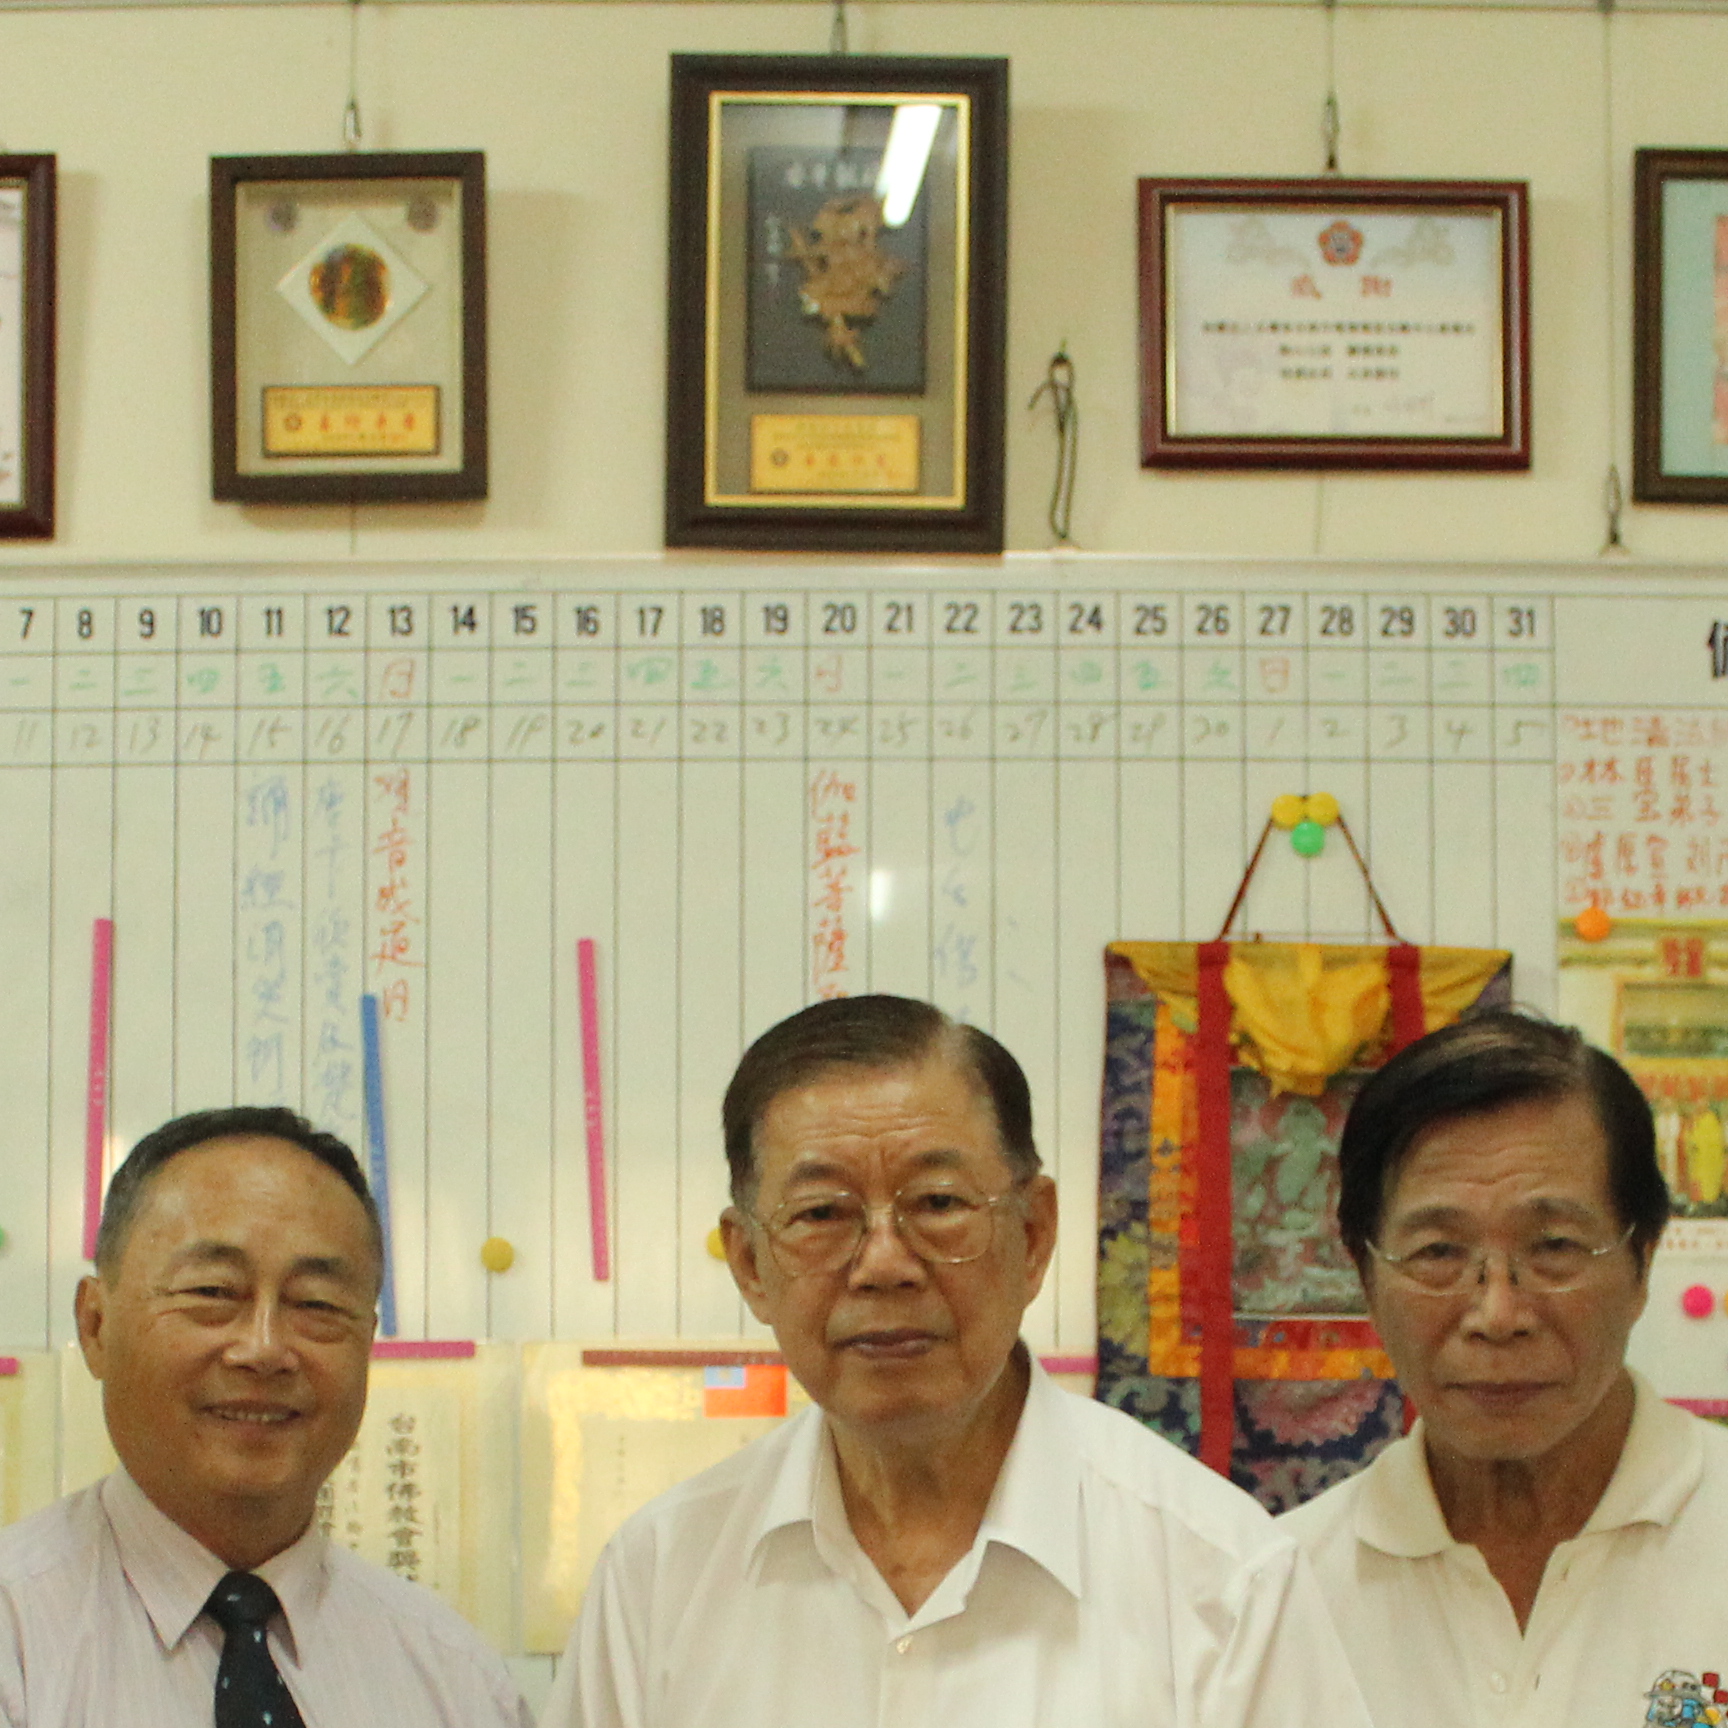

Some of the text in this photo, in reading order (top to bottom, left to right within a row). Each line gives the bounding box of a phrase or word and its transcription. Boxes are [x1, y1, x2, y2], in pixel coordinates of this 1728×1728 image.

[21, 608, 34, 639] 7
[78, 609, 93, 640] 8
[139, 609, 155, 639] 9
[199, 607, 223, 637] 10
[264, 608, 283, 636] 11
[326, 605, 351, 637] 12
[388, 605, 414, 636] 13
[452, 606, 477, 632] 14
[513, 605, 537, 635] 15
[575, 605, 599, 636] 16
[638, 606, 664, 636] 17
[700, 606, 725, 637] 18
[763, 604, 789, 635] 19
[823, 602, 857, 634] 20
[885, 602, 913, 633] 21
[945, 603, 978, 634] 22
[1009, 603, 1043, 634] 23
[1069, 604, 1103, 633] 24
[1134, 604, 1167, 636] 25
[1196, 604, 1229, 635] 26
[1259, 605, 1291, 636] 27
[1320, 605, 1354, 636] 28
[1381, 606, 1414, 637] 29
[1444, 607, 1476, 638] 30
[1508, 607, 1535, 638] 31
